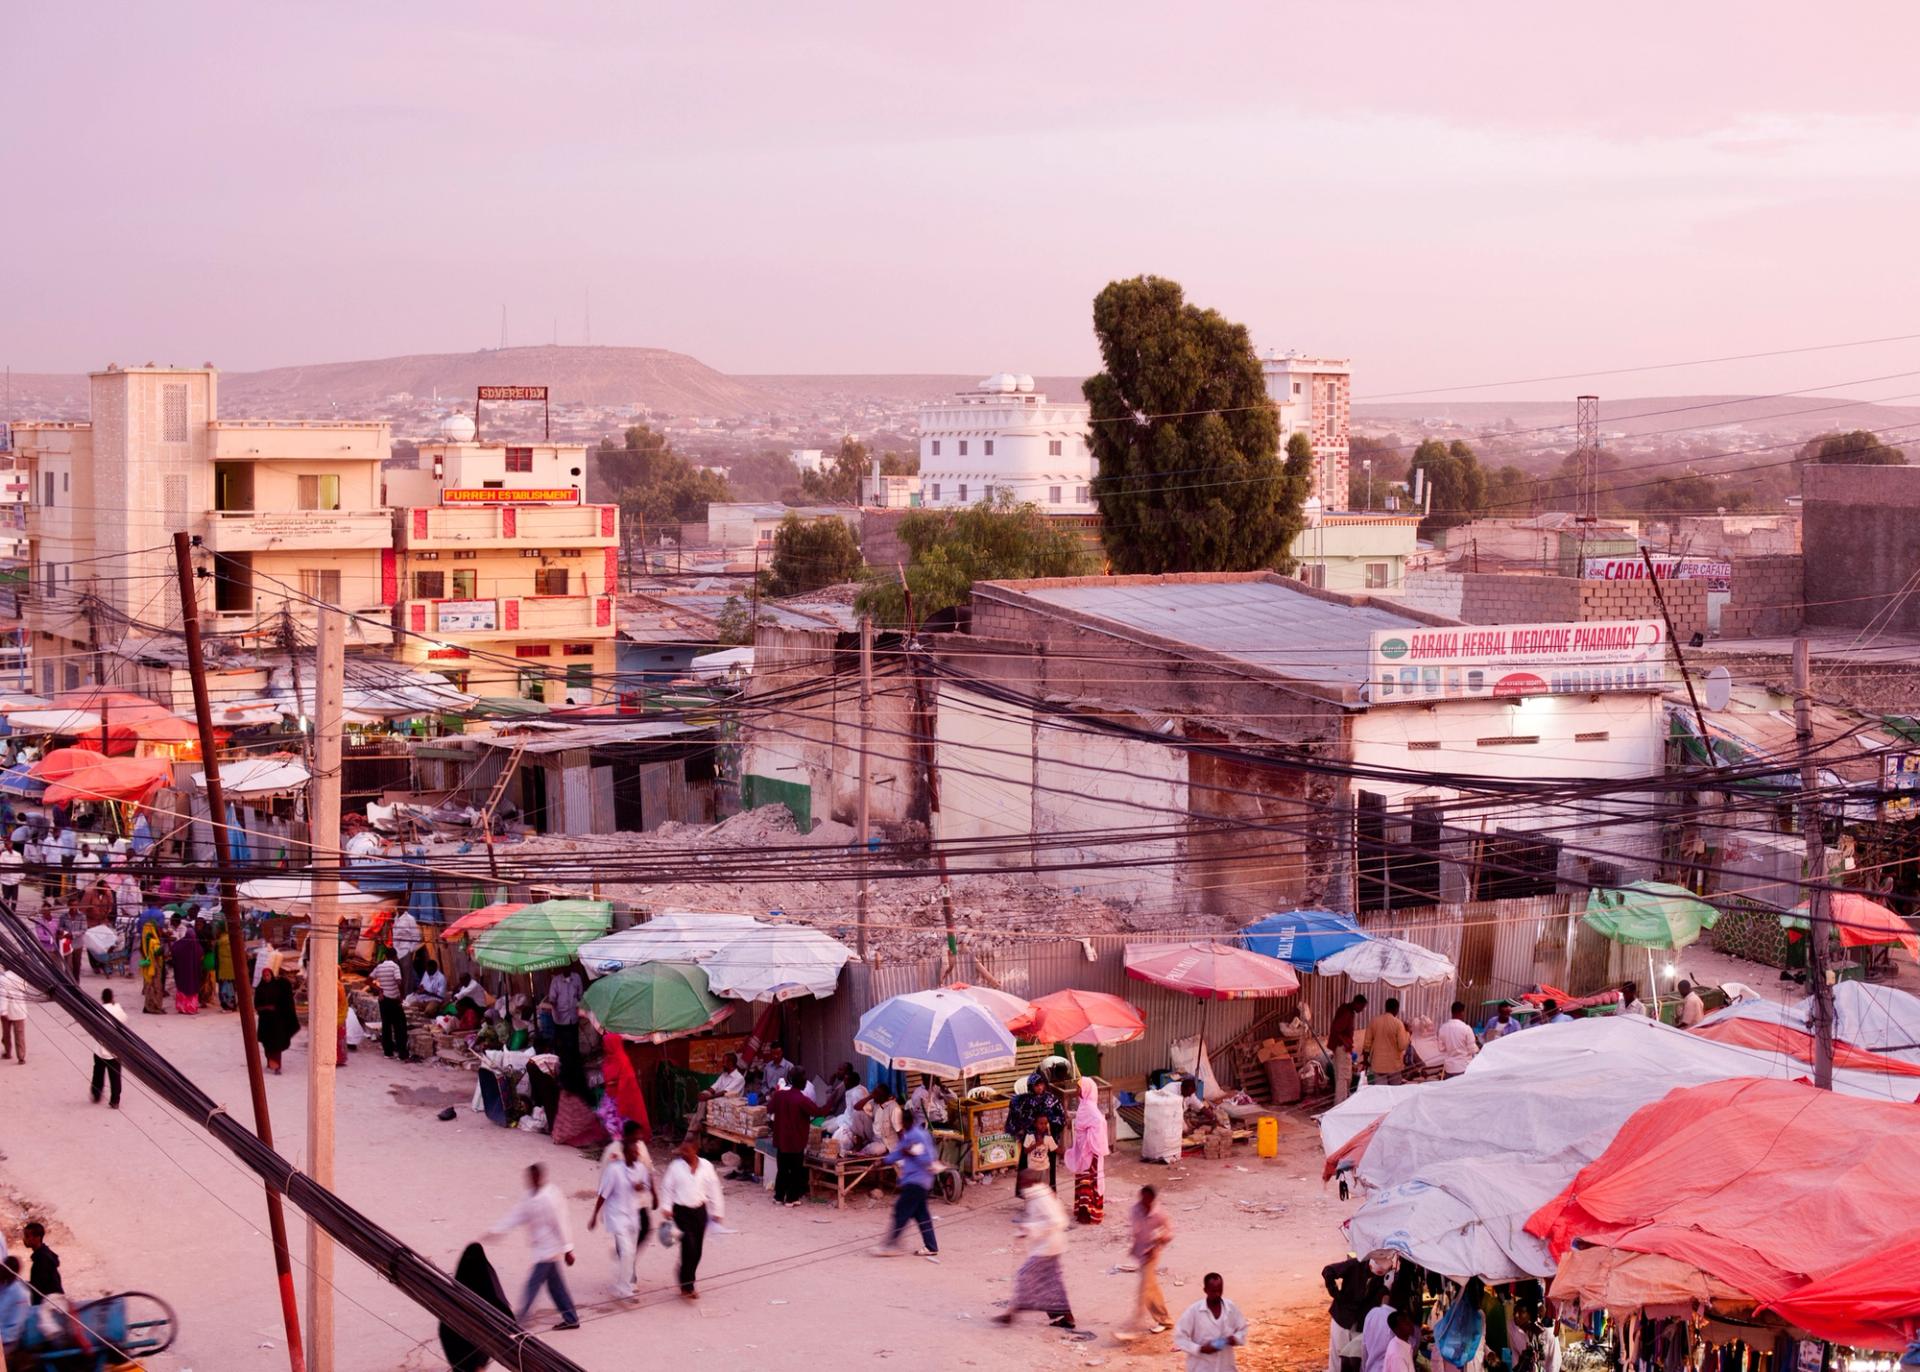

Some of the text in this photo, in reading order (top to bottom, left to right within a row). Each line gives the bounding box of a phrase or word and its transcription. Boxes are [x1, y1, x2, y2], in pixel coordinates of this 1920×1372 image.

[445, 490, 573, 501] FURREH ESTABLISHMENT
[1700, 563, 1731, 575] CAFATE
[1411, 633, 1458, 659] BARAKA
[1461, 630, 1507, 657] HERBAL
[1511, 627, 1571, 654] MEDICINE
[1573, 625, 1640, 652] PHARMACY
